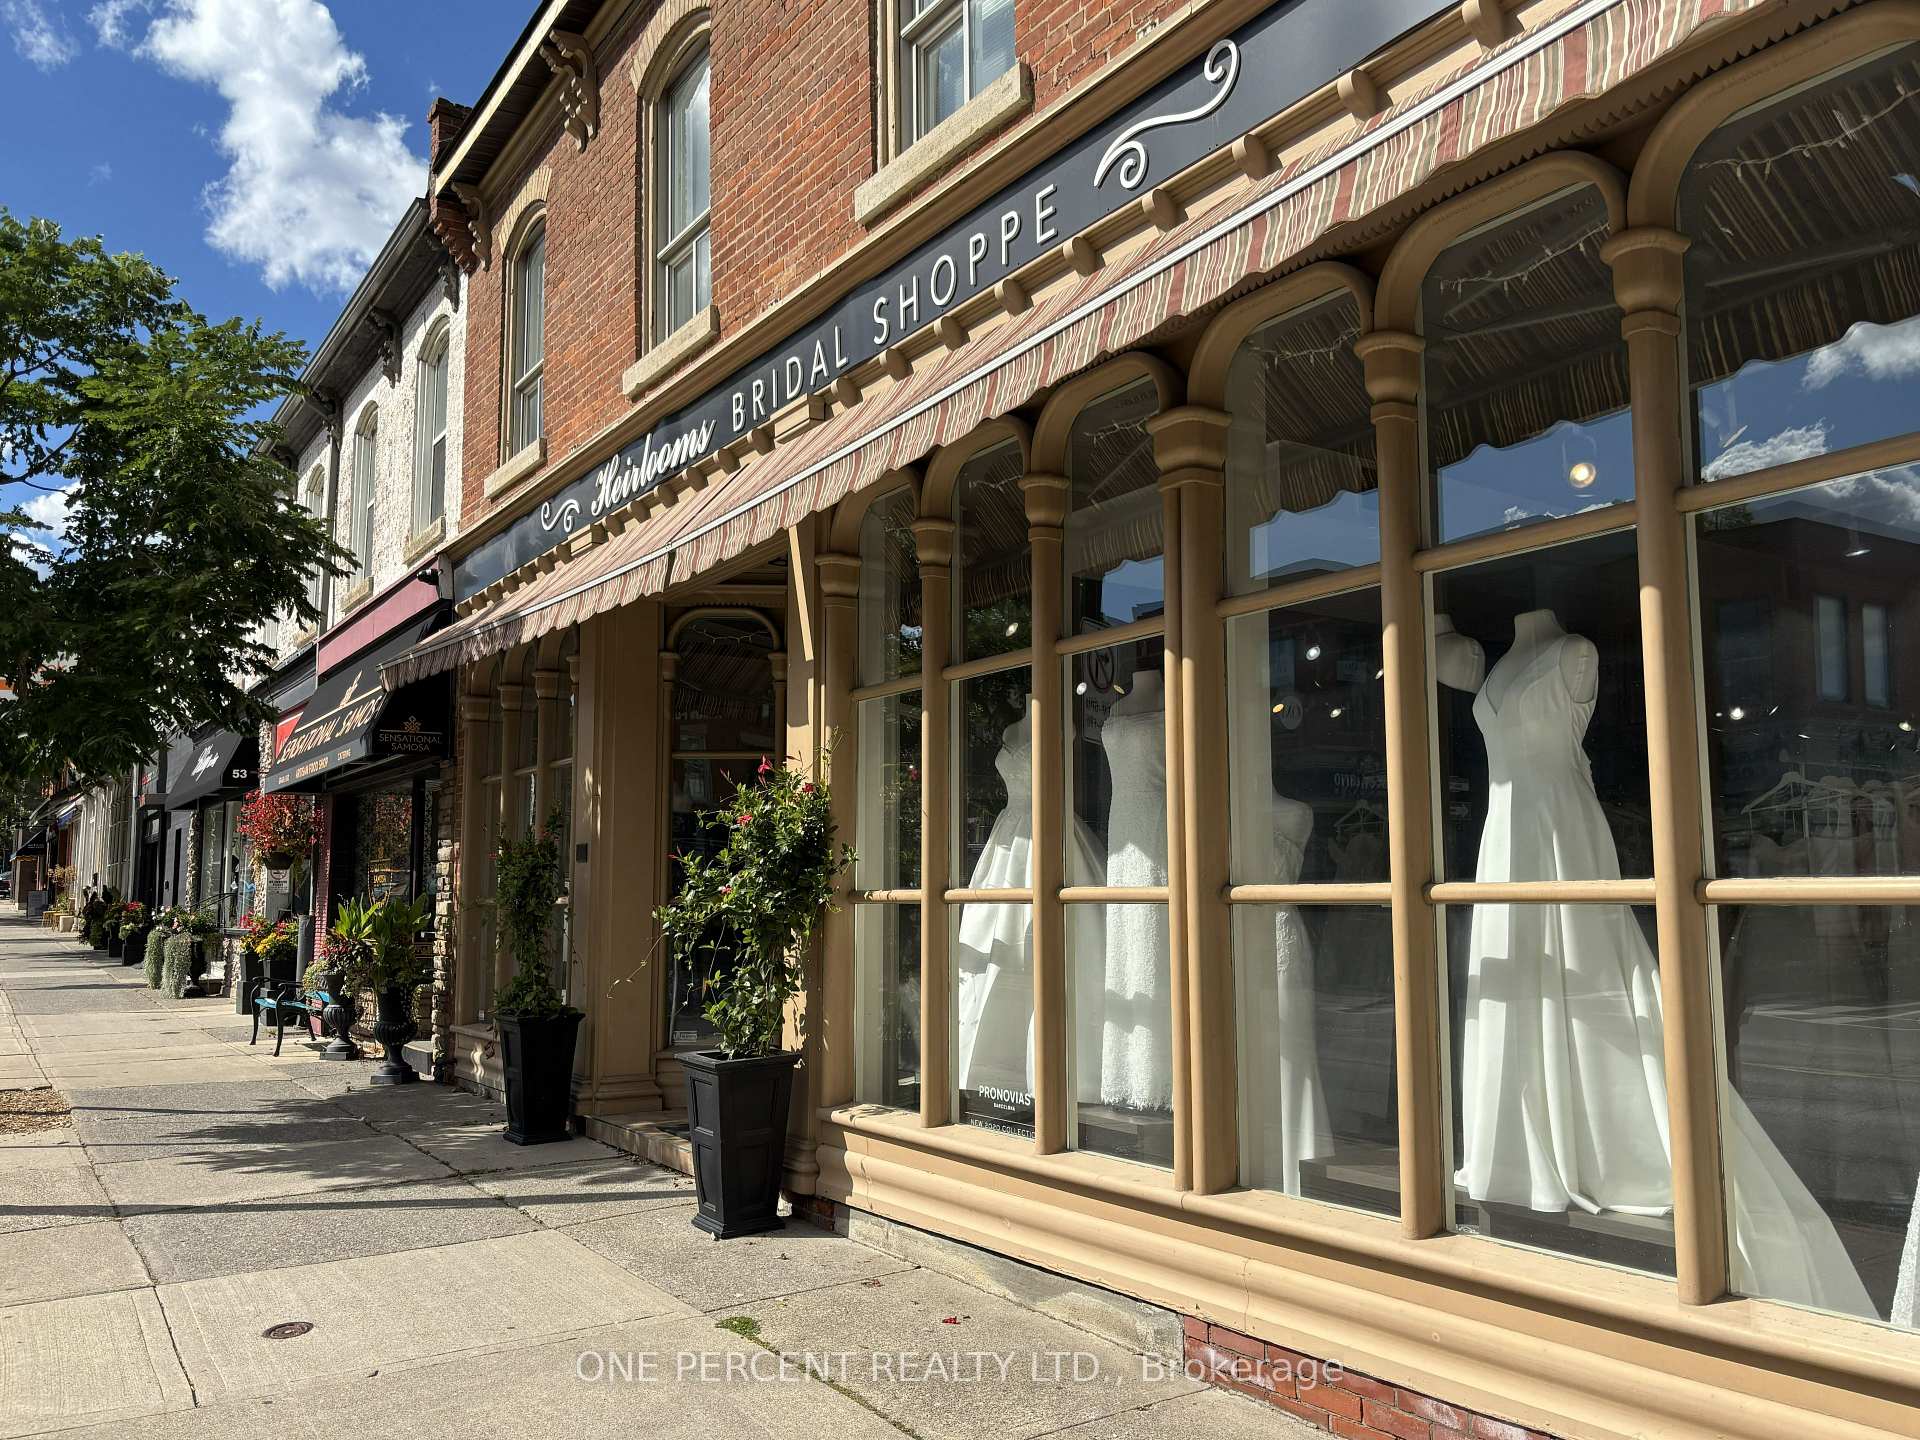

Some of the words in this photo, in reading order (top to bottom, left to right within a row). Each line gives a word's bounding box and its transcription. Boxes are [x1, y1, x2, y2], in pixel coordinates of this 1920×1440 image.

[591, 419, 717, 516] Heirlooms
[732, 324, 849, 432] BRIDAL
[873, 184, 1059, 345] SHOPPE
[379, 733, 442, 744] SENSATIONAL
[391, 742, 430, 752] SAMOSA
[232, 769, 247, 778] 53
[979, 1085, 1031, 1106] PRONOVIAS
[970, 1118, 983, 1128] NEW
